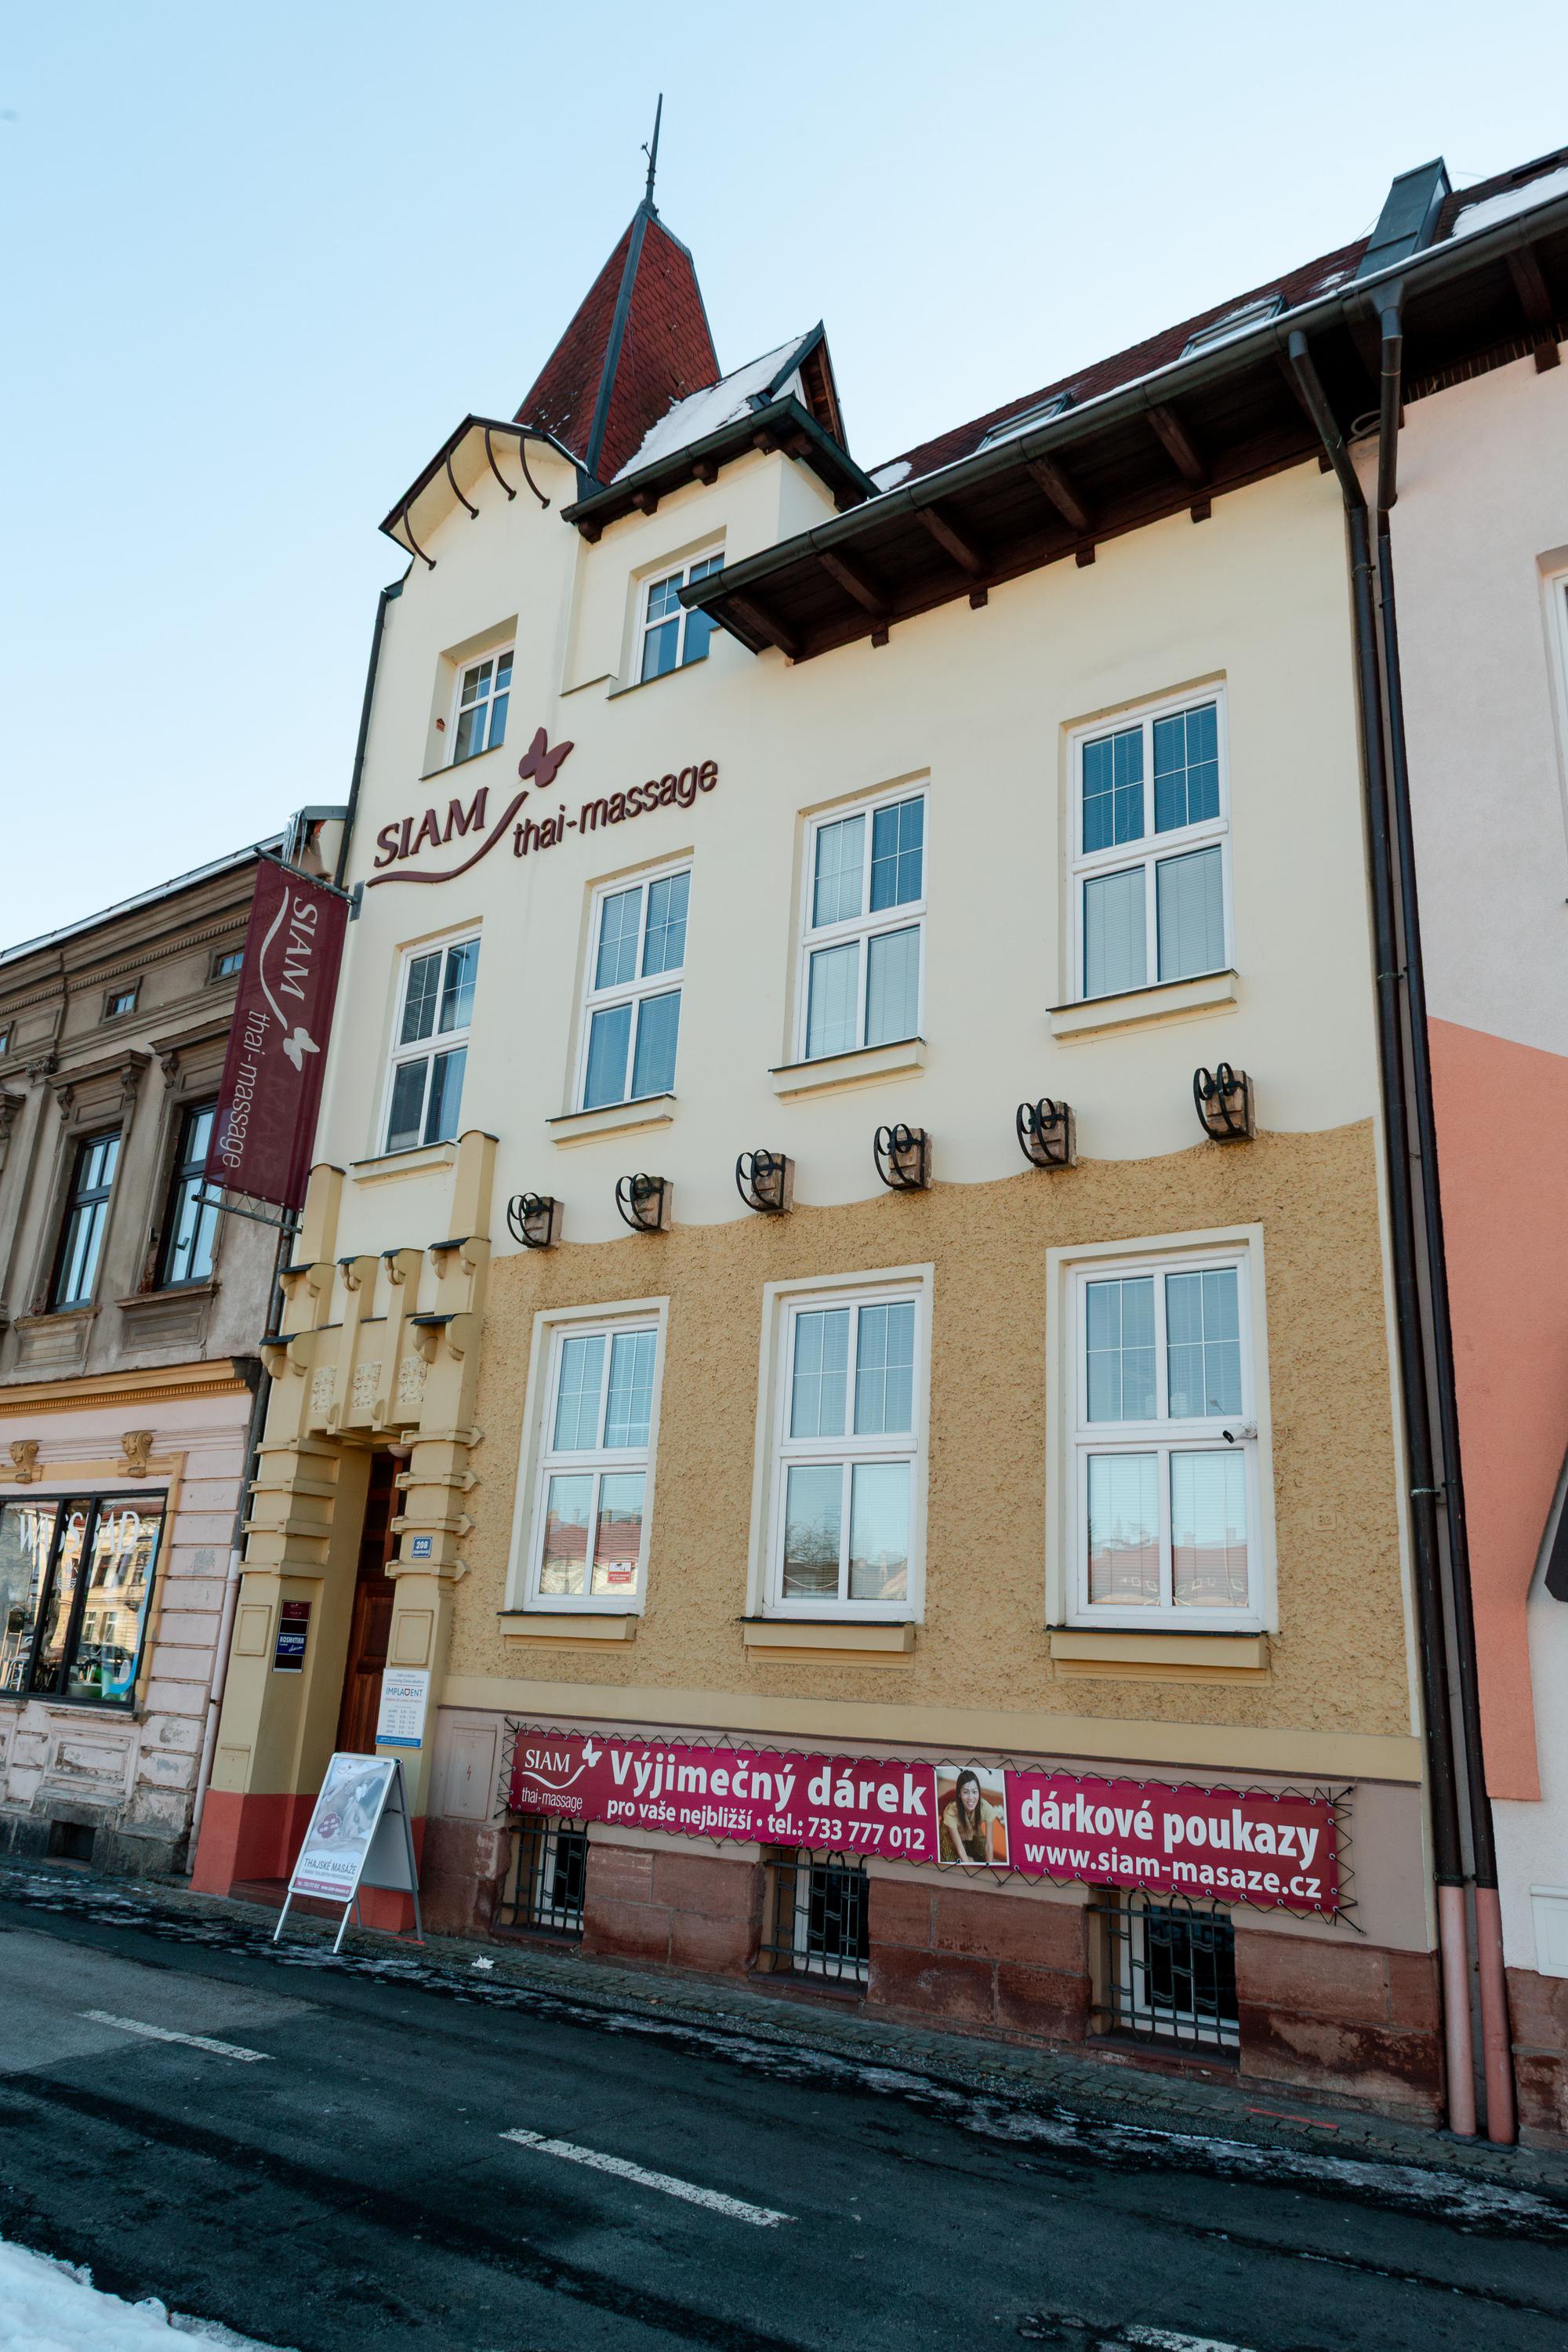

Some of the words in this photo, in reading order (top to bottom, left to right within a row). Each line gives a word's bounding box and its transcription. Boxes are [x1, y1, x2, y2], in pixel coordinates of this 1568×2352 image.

[373, 786, 489, 868] SIAM
[513, 760, 719, 857] thai-massage
[280, 896, 318, 1001] SIAM
[220, 1011, 270, 1168] thai-massage
[416, 1541, 428, 1549] 208
[524, 1749, 571, 1773] SIAM
[610, 1750, 796, 1813] Výjimečný
[808, 1766, 927, 1816] dárek
[521, 1787, 583, 1812] thai-massage
[607, 1799, 635, 1819] pro
[639, 1801, 676, 1821] vaše
[681, 1806, 753, 1831] nejbližší
[768, 1813, 803, 1836] tel.:
[808, 1817, 842, 1840] 733
[848, 1821, 884, 1845] 777
[889, 1826, 925, 1850] 012
[1021, 1789, 1154, 1840] dárkové
[1163, 1809, 1319, 1870] poukazy
[304, 1858, 332, 1871] THAJSKÉ
[331, 1863, 358, 1875] MASÁŽE
[1024, 1843, 1322, 1899] www.siam-masaze.cz
